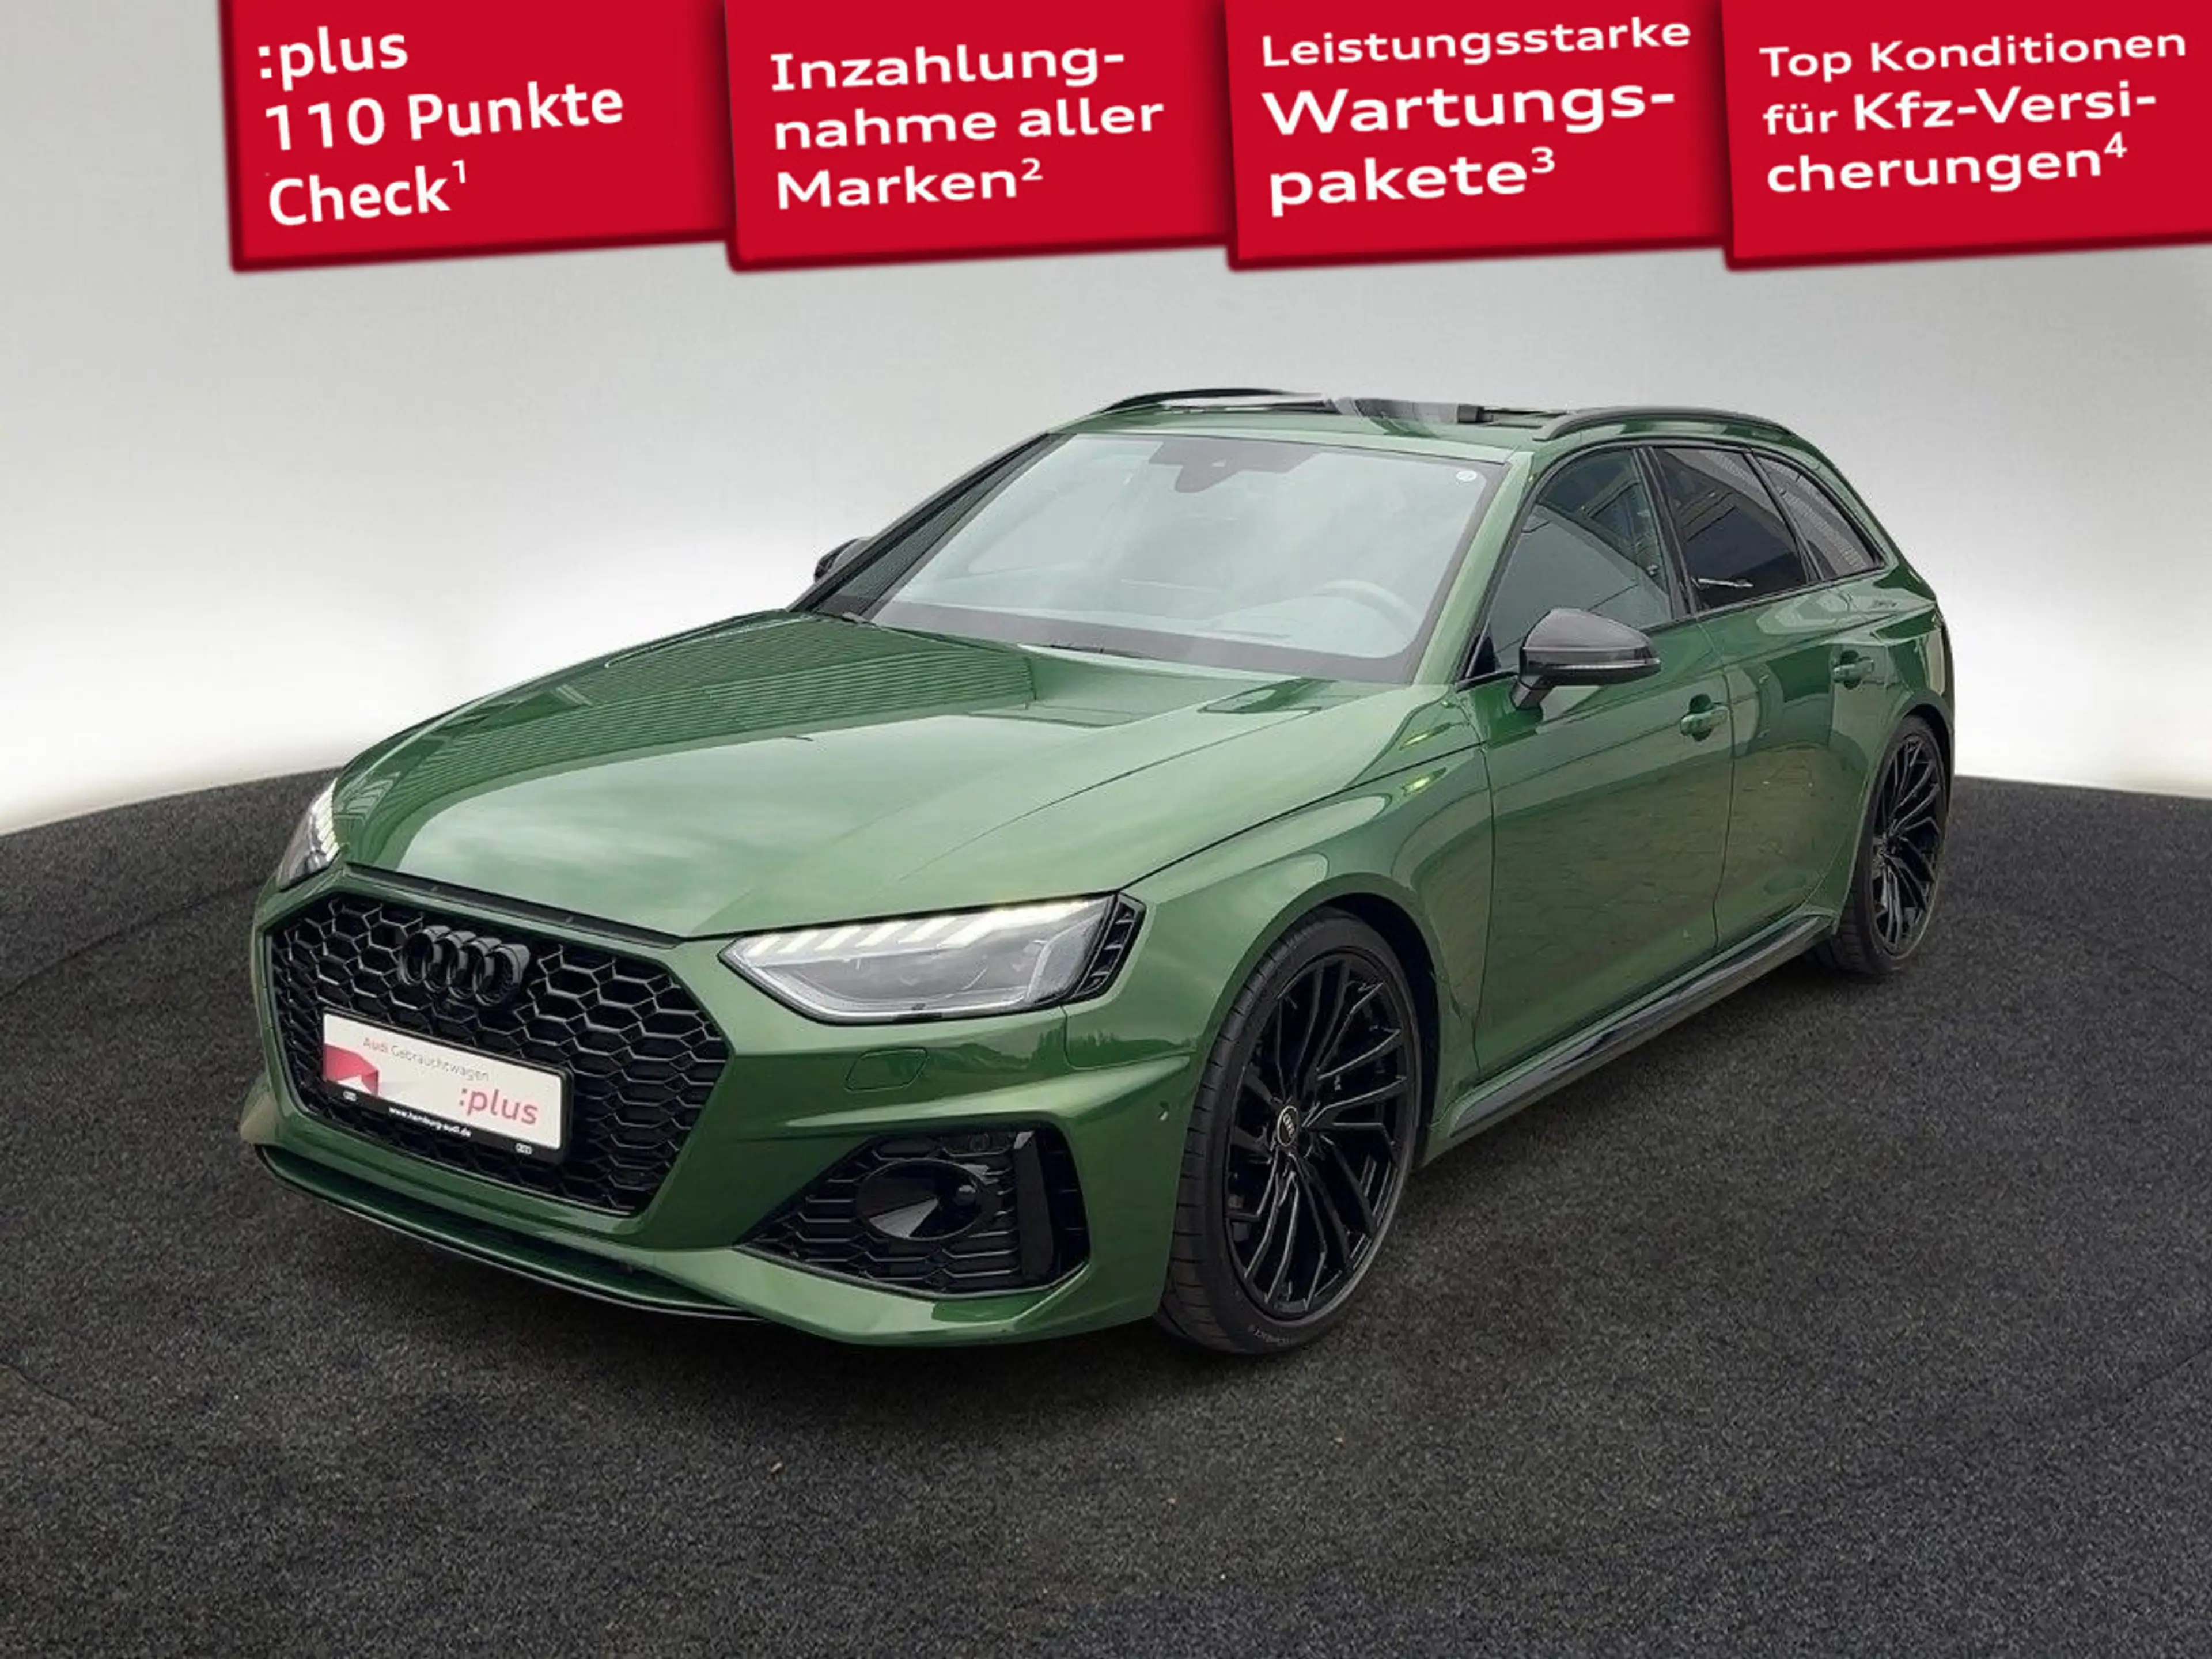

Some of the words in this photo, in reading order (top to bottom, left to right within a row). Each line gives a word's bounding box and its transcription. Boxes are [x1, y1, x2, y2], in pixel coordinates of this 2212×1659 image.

[363, 1037, 388, 1054] Audi
[390, 1044, 490, 1081] Gebrauchtwagen
[459, 1087, 539, 1125] :plus
